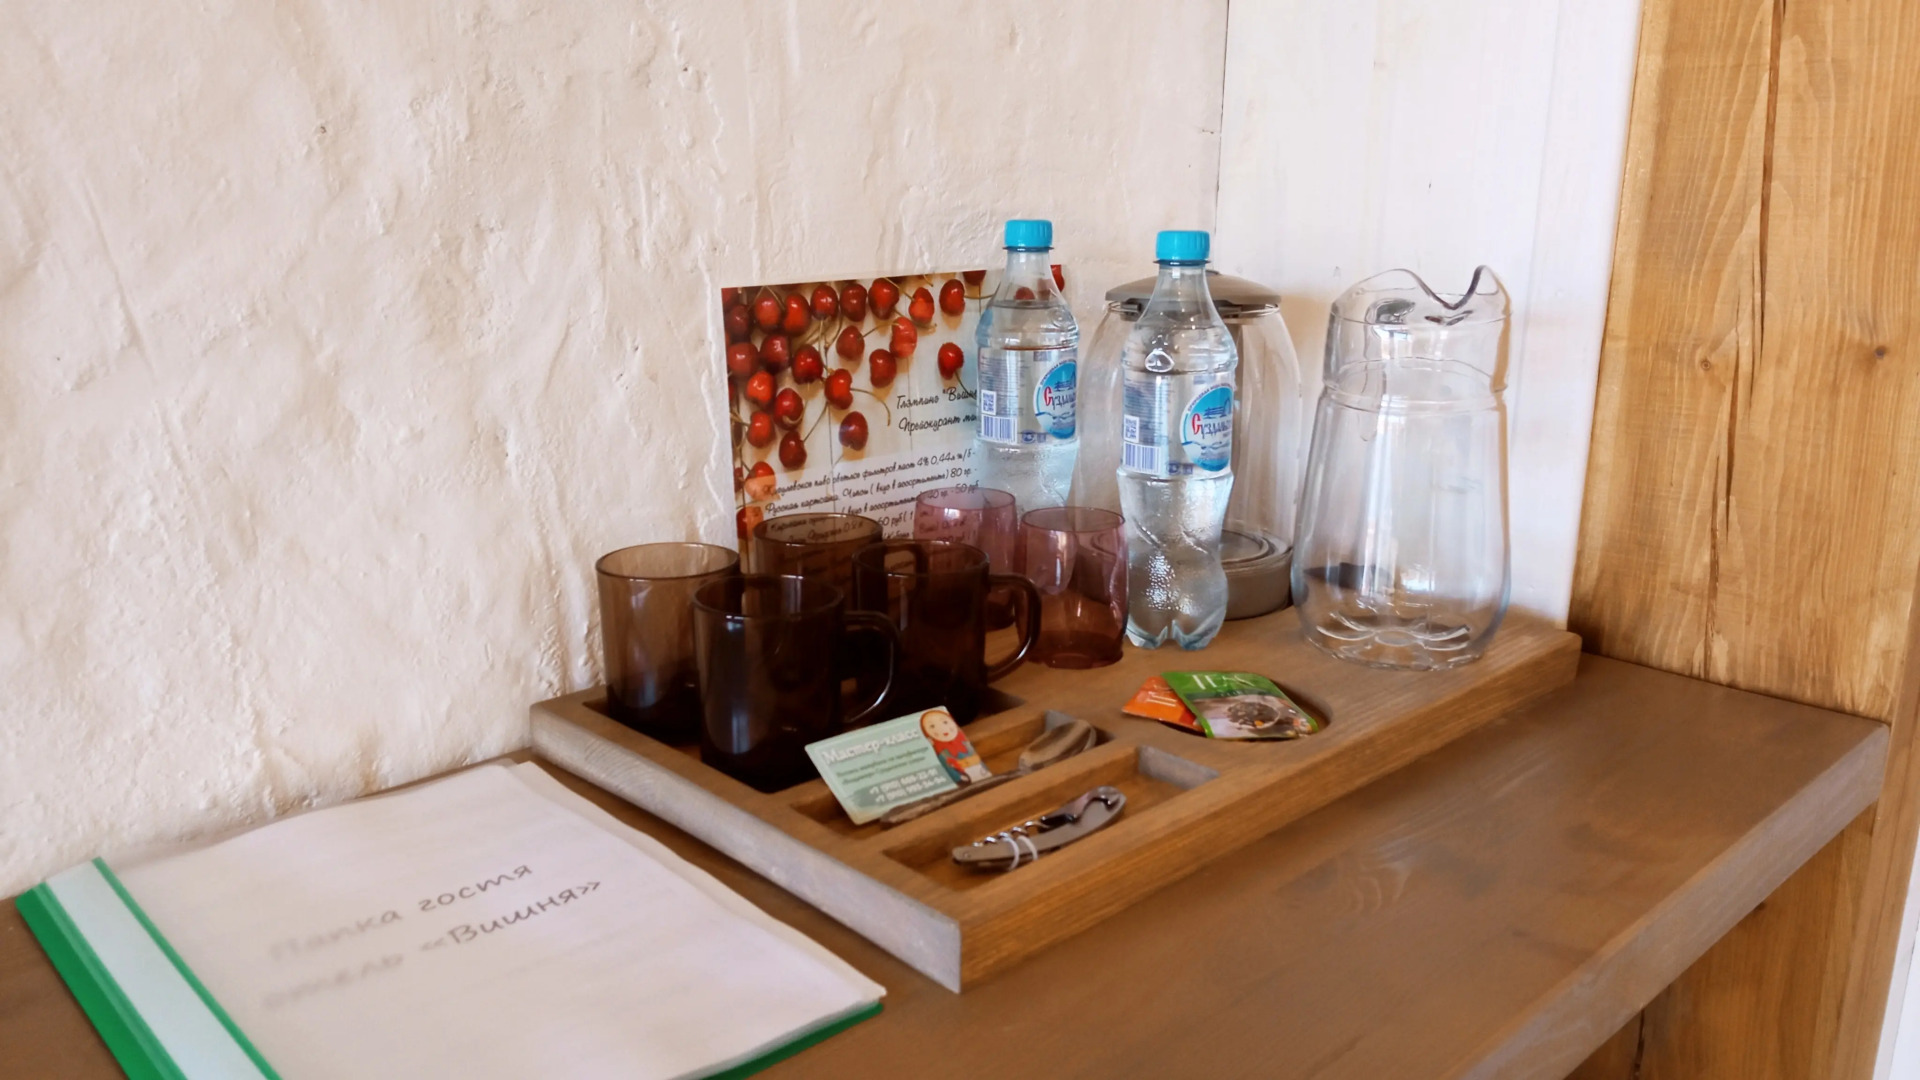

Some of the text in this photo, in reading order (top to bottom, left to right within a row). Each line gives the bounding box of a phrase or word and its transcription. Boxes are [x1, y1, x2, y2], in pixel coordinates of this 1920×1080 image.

[821, 728, 920, 764] Мастер-класс
[418, 864, 533, 912] гостя
[419, 881, 601, 951] «Вишня»
